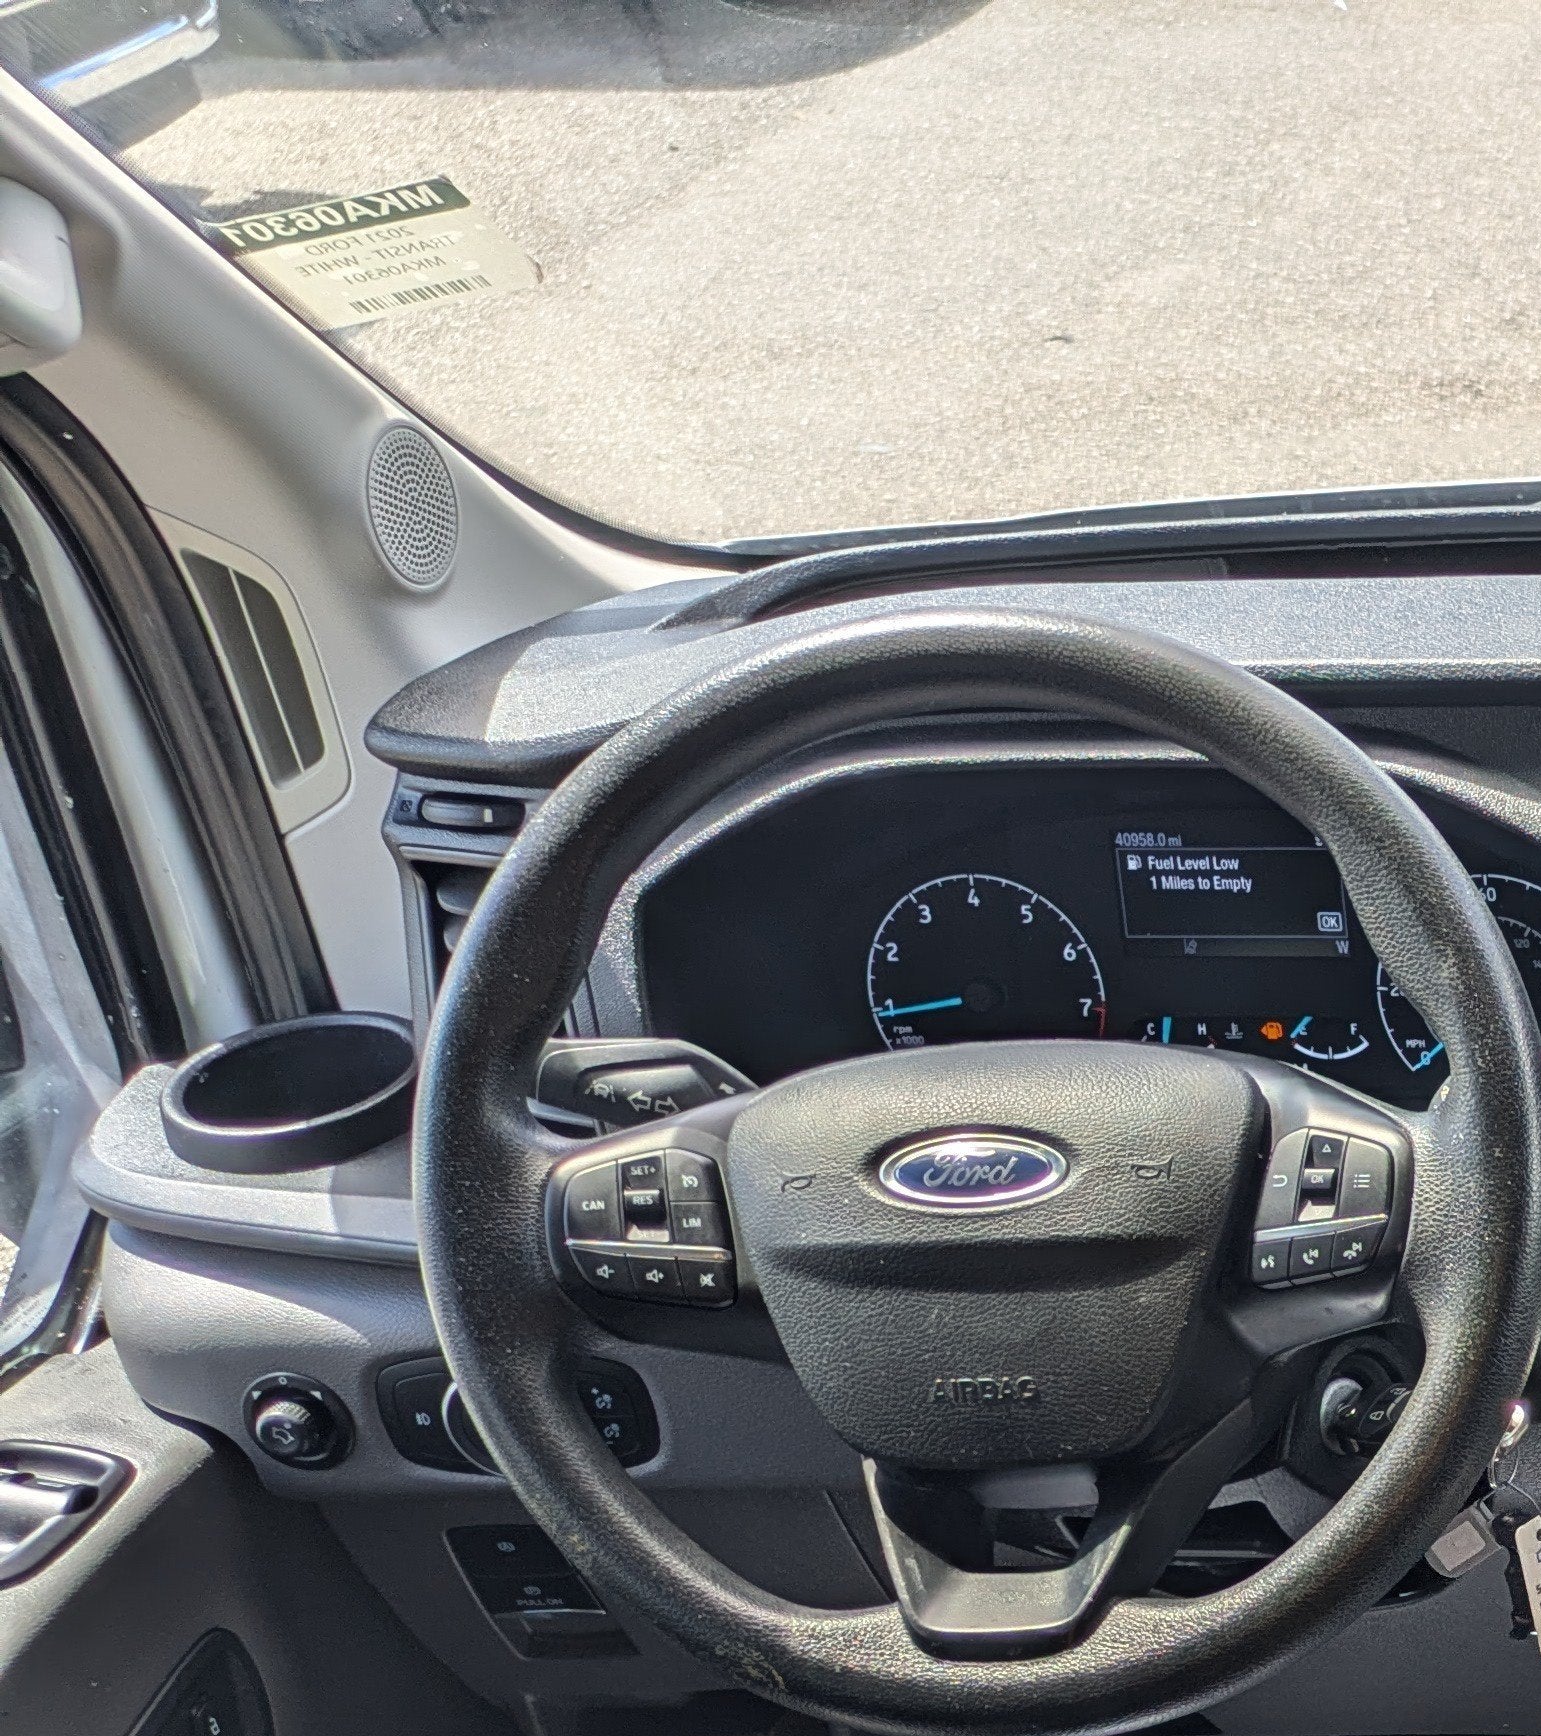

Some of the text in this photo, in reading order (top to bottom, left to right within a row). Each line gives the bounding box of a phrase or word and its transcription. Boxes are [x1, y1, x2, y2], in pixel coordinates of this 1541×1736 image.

[1115, 833, 1182, 847] 40958.0 mi
[1148, 856, 1240, 870] Fuel Level Low
[1150, 876, 1253, 893] 1 Miles to Empty
[967, 888, 980, 907] 4
[918, 904, 932, 924] 3
[1020, 904, 1033, 924] 5
[1321, 917, 1339, 928] OK
[886, 942, 899, 962] 2
[1063, 942, 1076, 961] 6
[1335, 940, 1349, 954] W
[884, 998, 895, 1016] 1
[1079, 998, 1092, 1017] 7
[893, 1025, 913, 1035] rpm
[1146, 1023, 1155, 1035] C
[1197, 1023, 1207, 1035] H
[1350, 1022, 1357, 1035] F
[1405, 1039, 1426, 1048] MPH
[923, 1148, 1019, 1187] Ford
[1310, 1174, 1324, 1184] OK
[582, 1200, 605, 1211] CAN
[632, 1196, 653, 1205] RES
[682, 1217, 702, 1228] LIM
